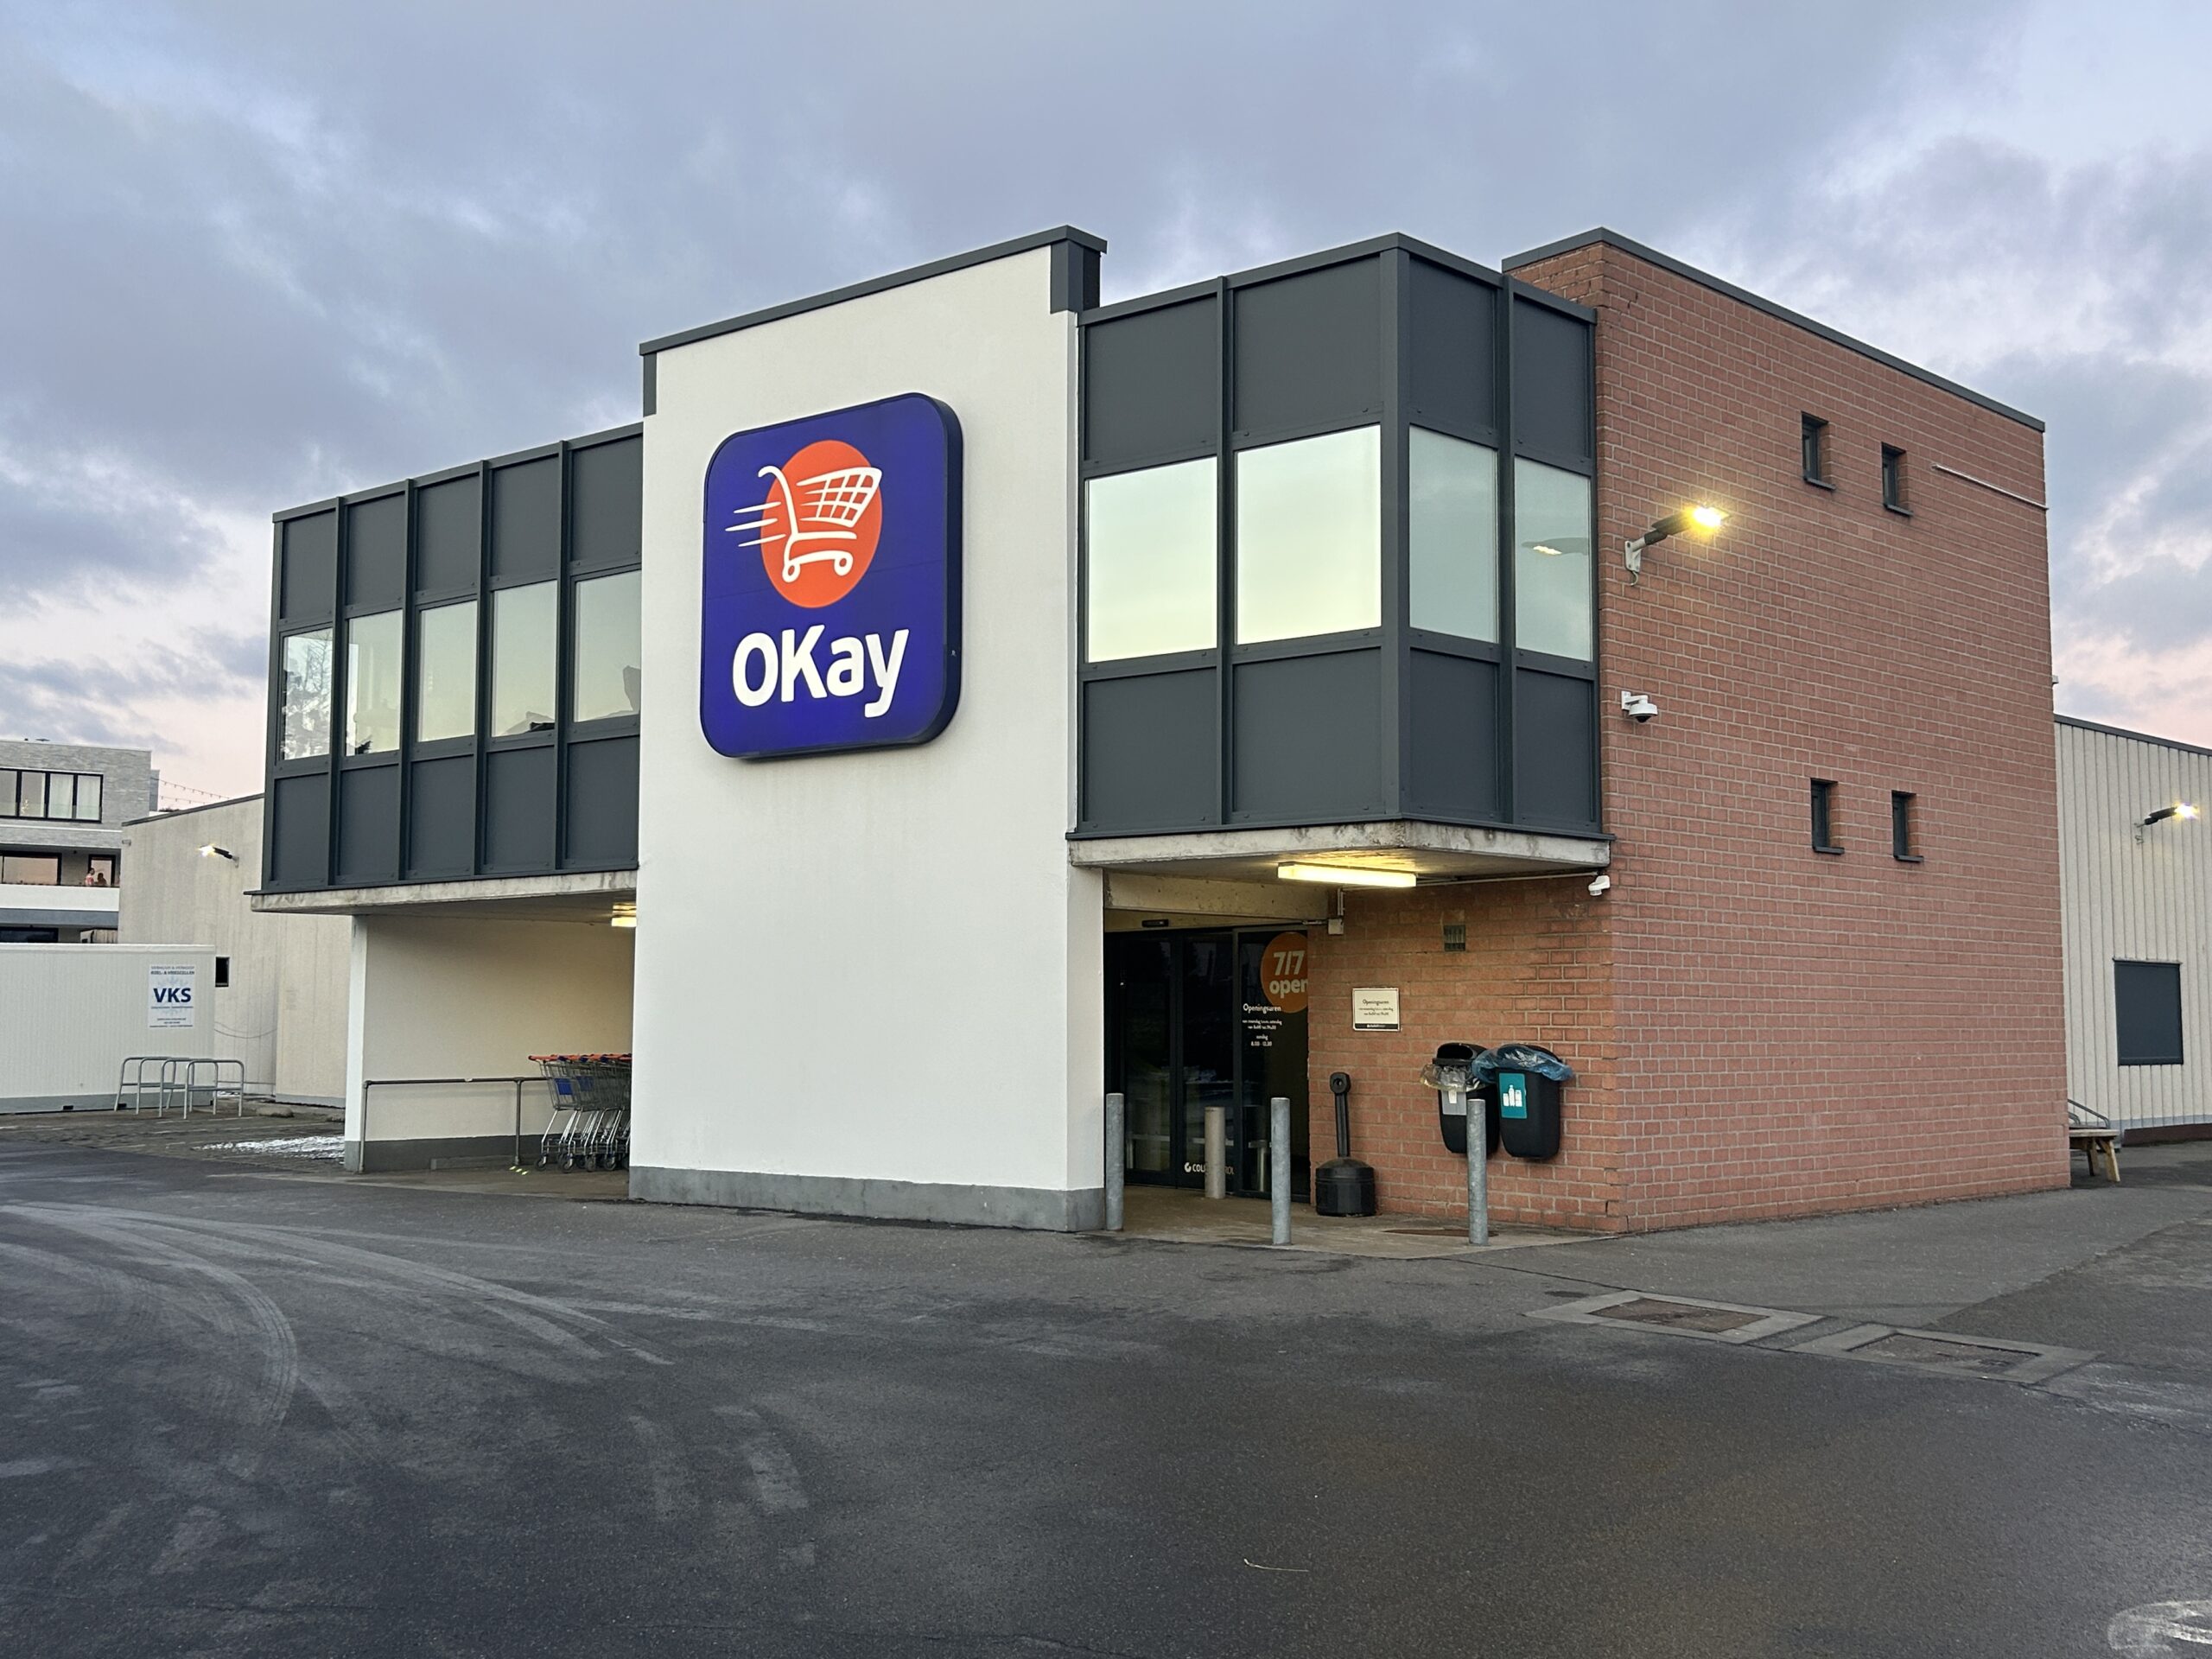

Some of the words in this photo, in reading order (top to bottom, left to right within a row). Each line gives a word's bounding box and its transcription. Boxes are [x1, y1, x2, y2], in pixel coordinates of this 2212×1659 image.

[733, 625, 910, 718] OKay
[1273, 950, 1306, 976] 7/7
[153, 988, 191, 1002] VKS
